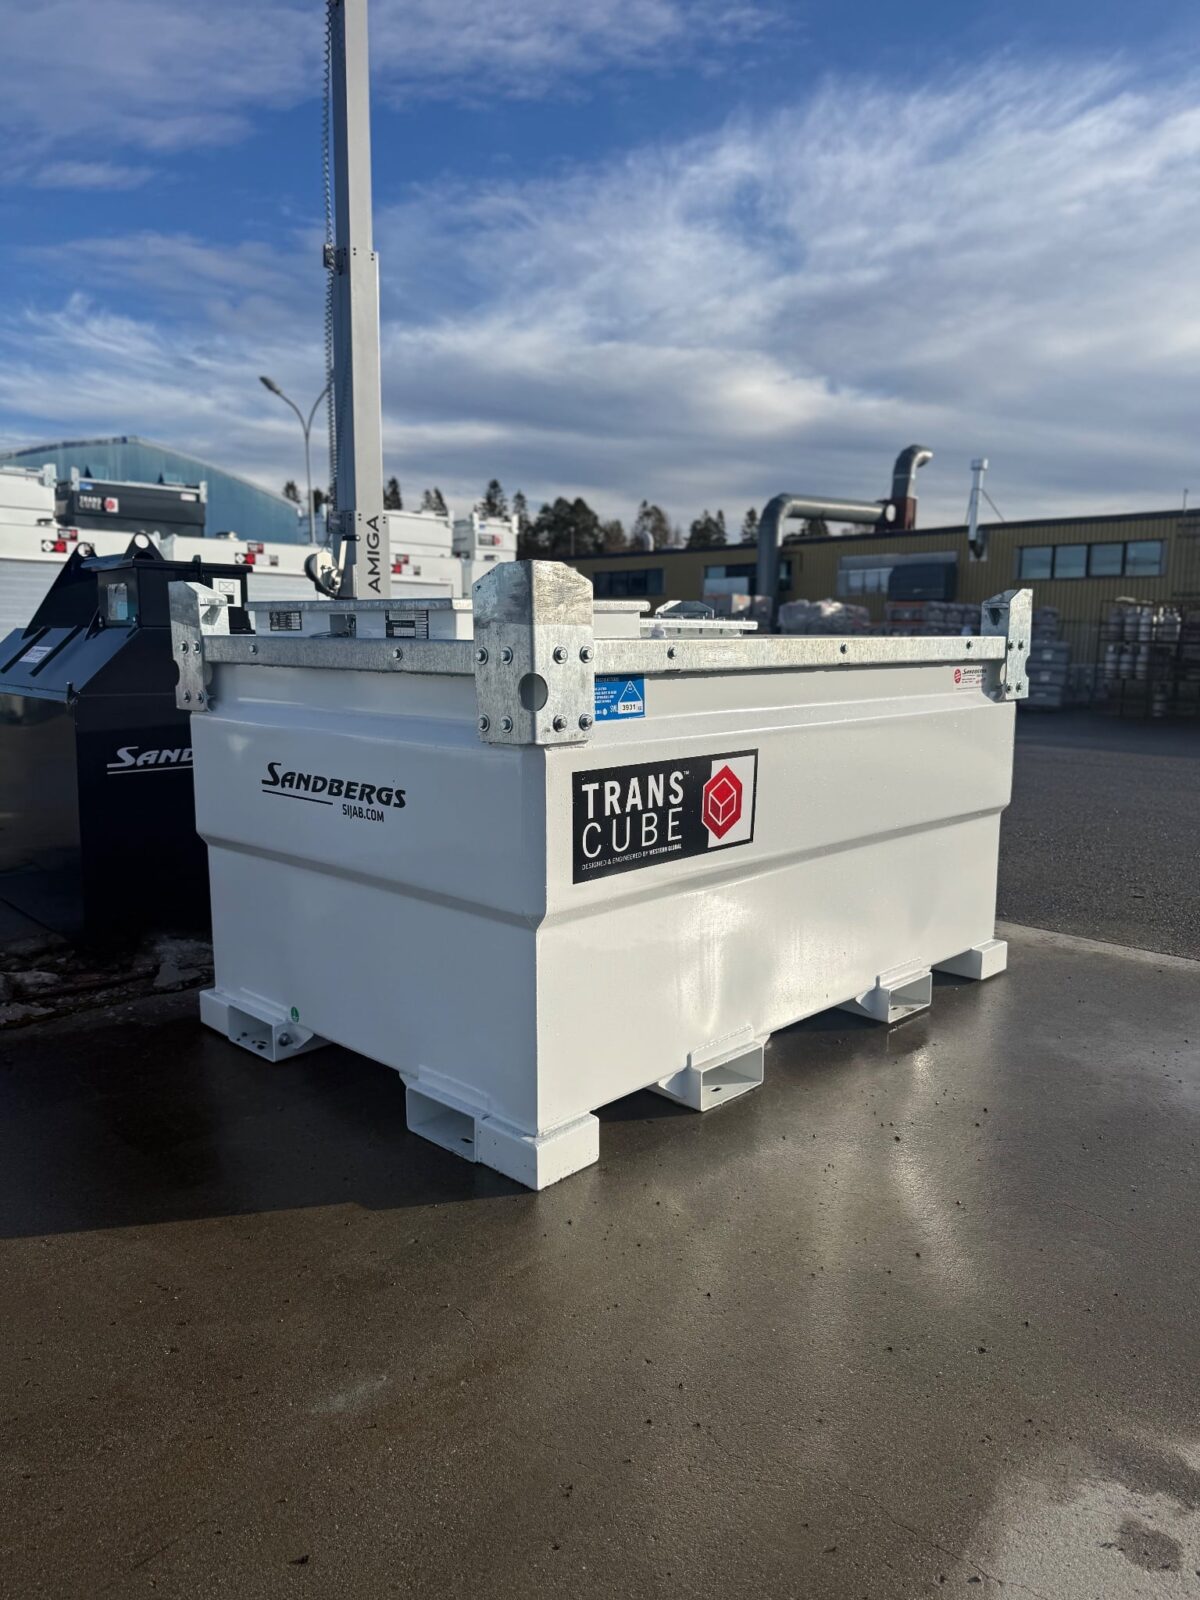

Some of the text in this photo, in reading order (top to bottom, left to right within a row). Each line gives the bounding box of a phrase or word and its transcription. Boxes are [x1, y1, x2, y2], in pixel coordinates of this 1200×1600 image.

[366, 515, 381, 594] AMIGA
[622, 703, 636, 711] 3931
[342, 804, 385, 822] SIJAB.COM
[582, 771, 683, 819] TRANS
[582, 807, 683, 858] CUBE
[581, 858, 607, 871] DESIGNED
[606, 857, 612, 865] &
[611, 850, 643, 865] ENGINEERED
[649, 845, 668, 854] WESTERN
[668, 842, 683, 851] GLOBAL
